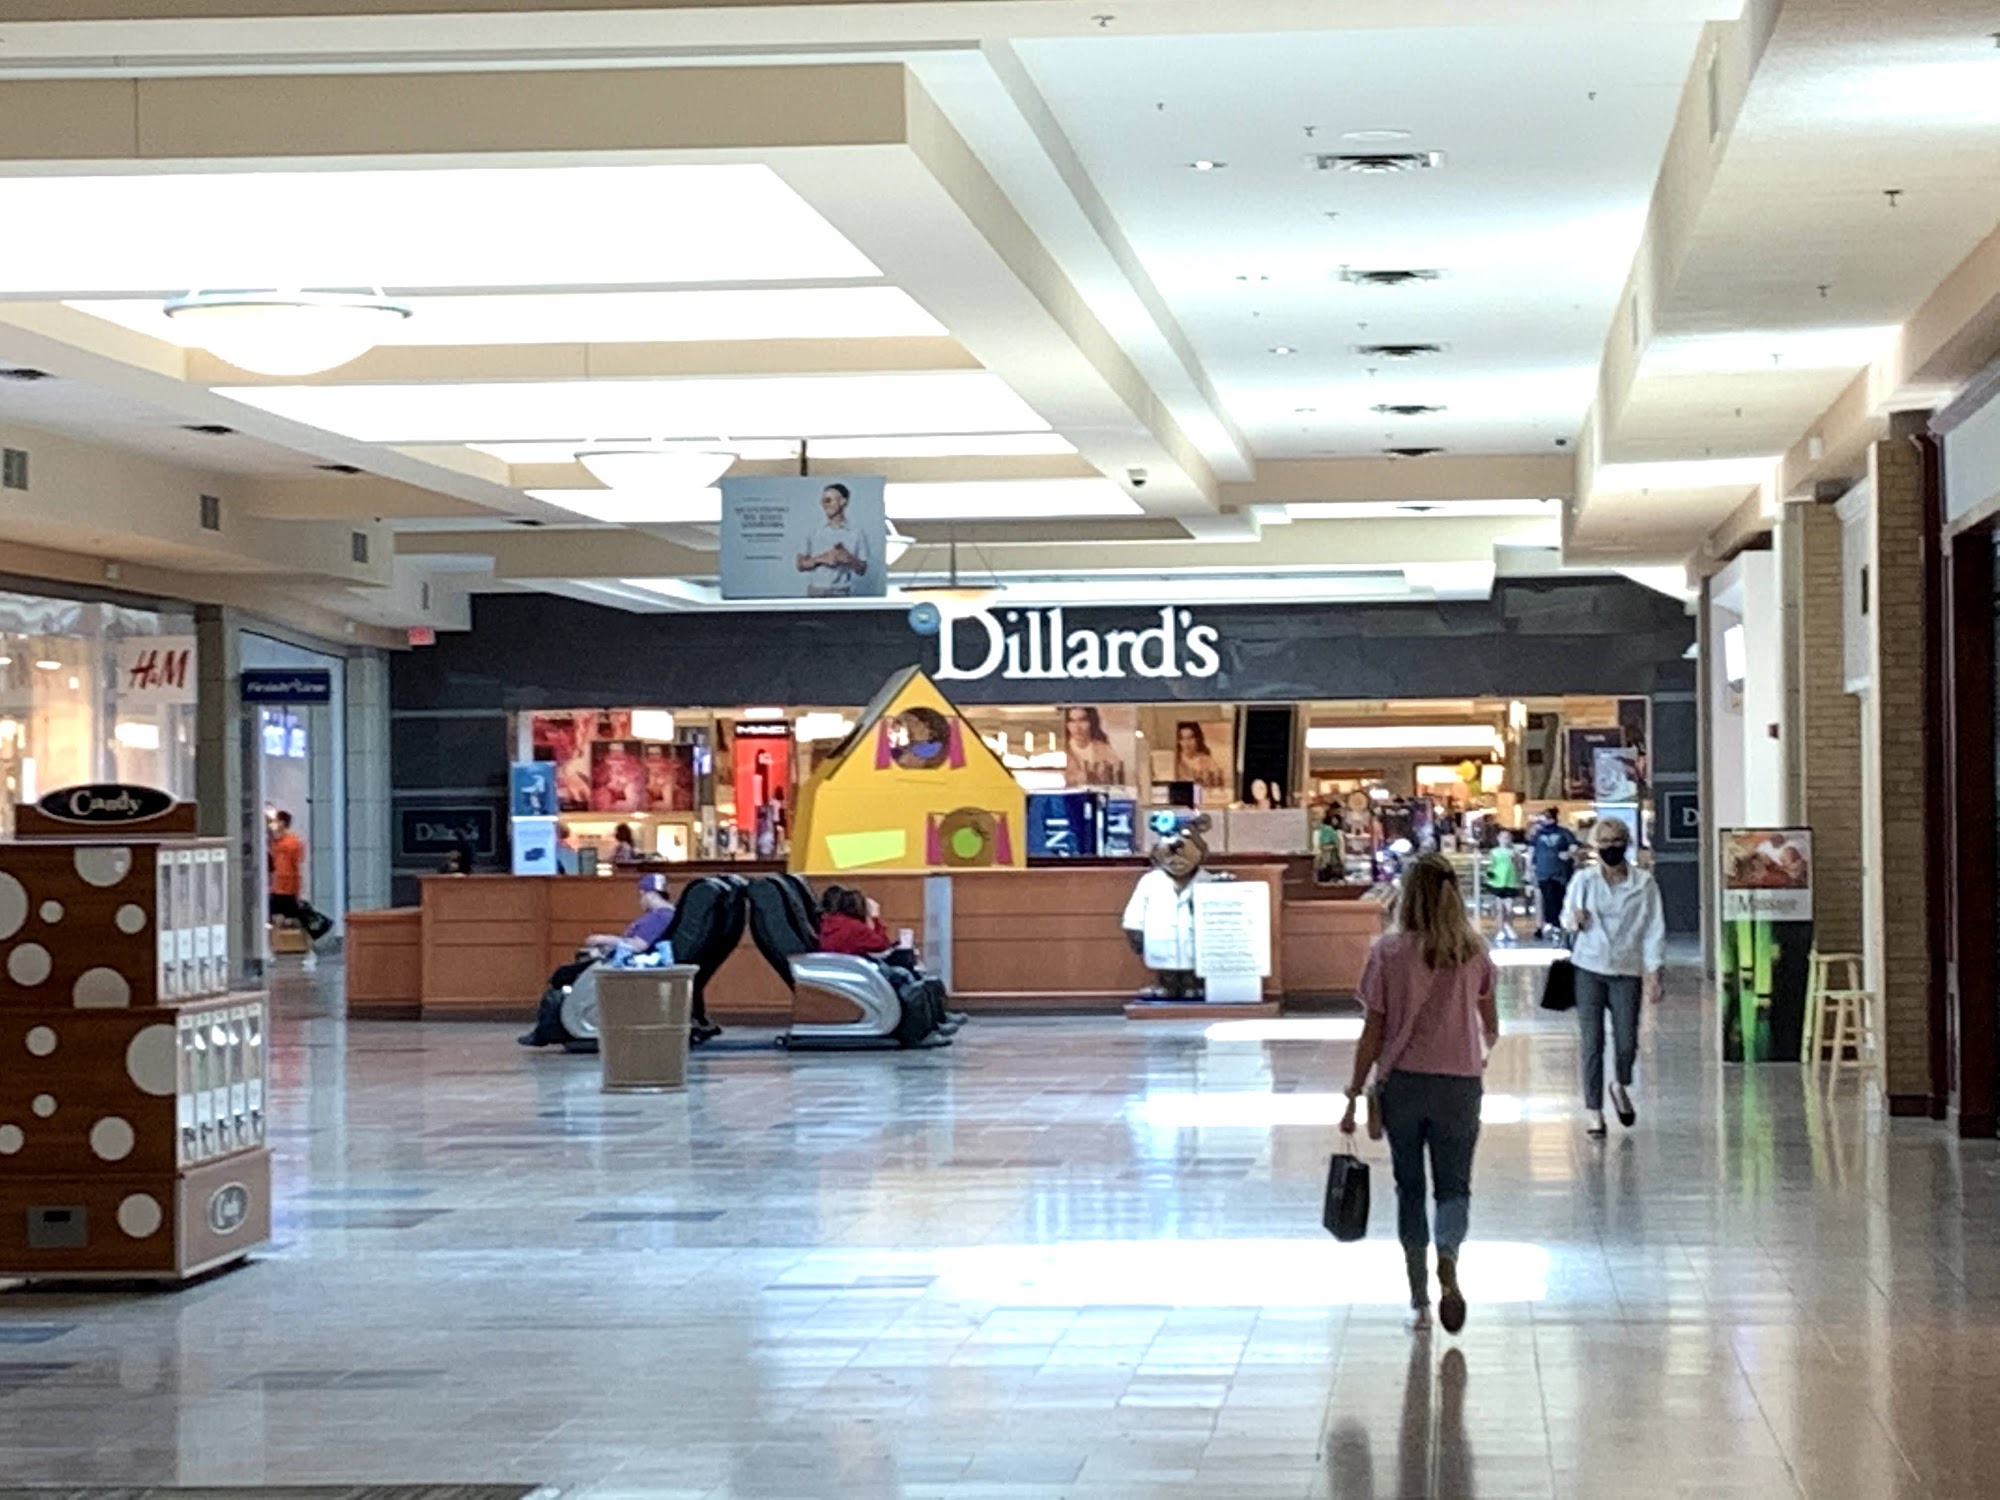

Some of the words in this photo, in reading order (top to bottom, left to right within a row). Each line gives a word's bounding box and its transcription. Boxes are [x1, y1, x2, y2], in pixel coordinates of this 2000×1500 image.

[932, 605, 1220, 680] Dillard's
[129, 650, 190, 689] H&M
[70, 790, 142, 816] Candy
